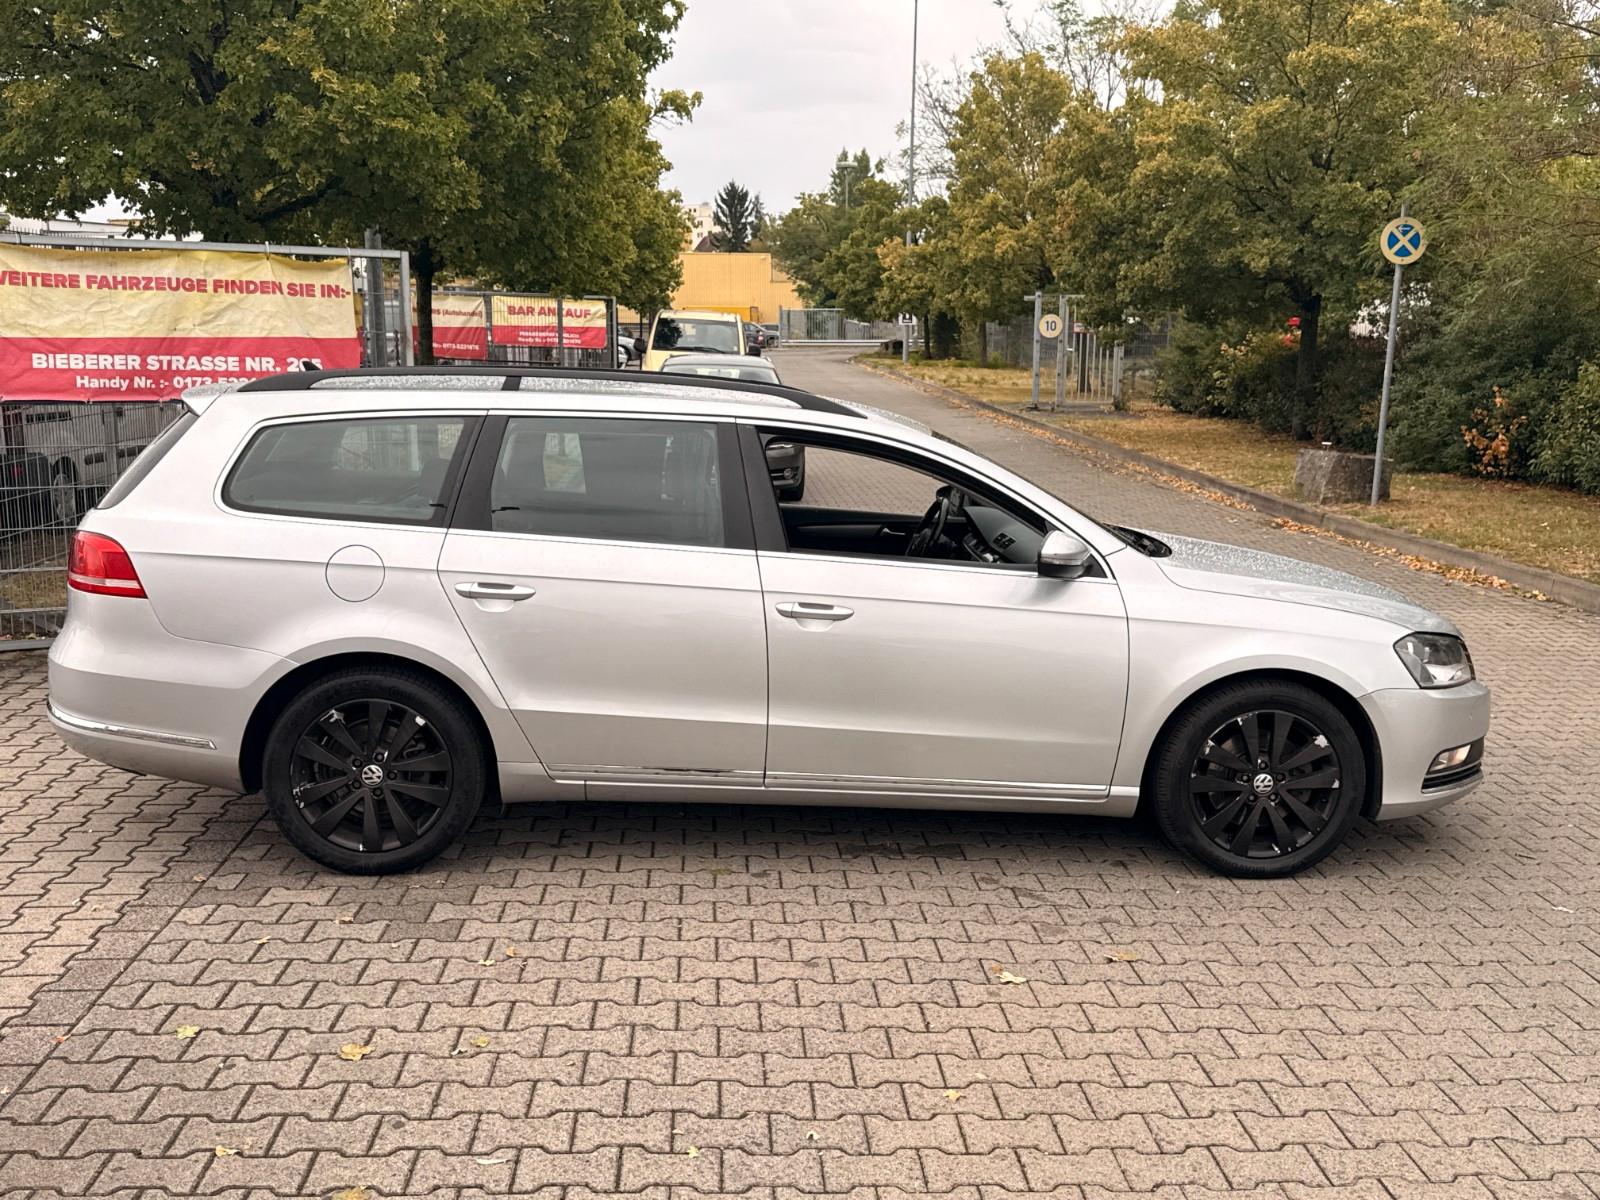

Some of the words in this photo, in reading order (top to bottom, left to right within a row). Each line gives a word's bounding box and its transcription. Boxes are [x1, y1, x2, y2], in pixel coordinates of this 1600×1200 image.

[86, 275, 207, 293] FAHRZEUGE
[213, 279, 283, 295] FINDEN
[287, 282, 316, 298] SIE
[507, 305, 535, 316] BAR
[538, 306, 592, 319] ANAUF
[1045, 320, 1057, 332] 10
[32, 353, 142, 370] BIEBERER
[146, 355, 239, 371] STRASSE
[245, 356, 281, 372] NR.
[76, 375, 129, 391] Handy
